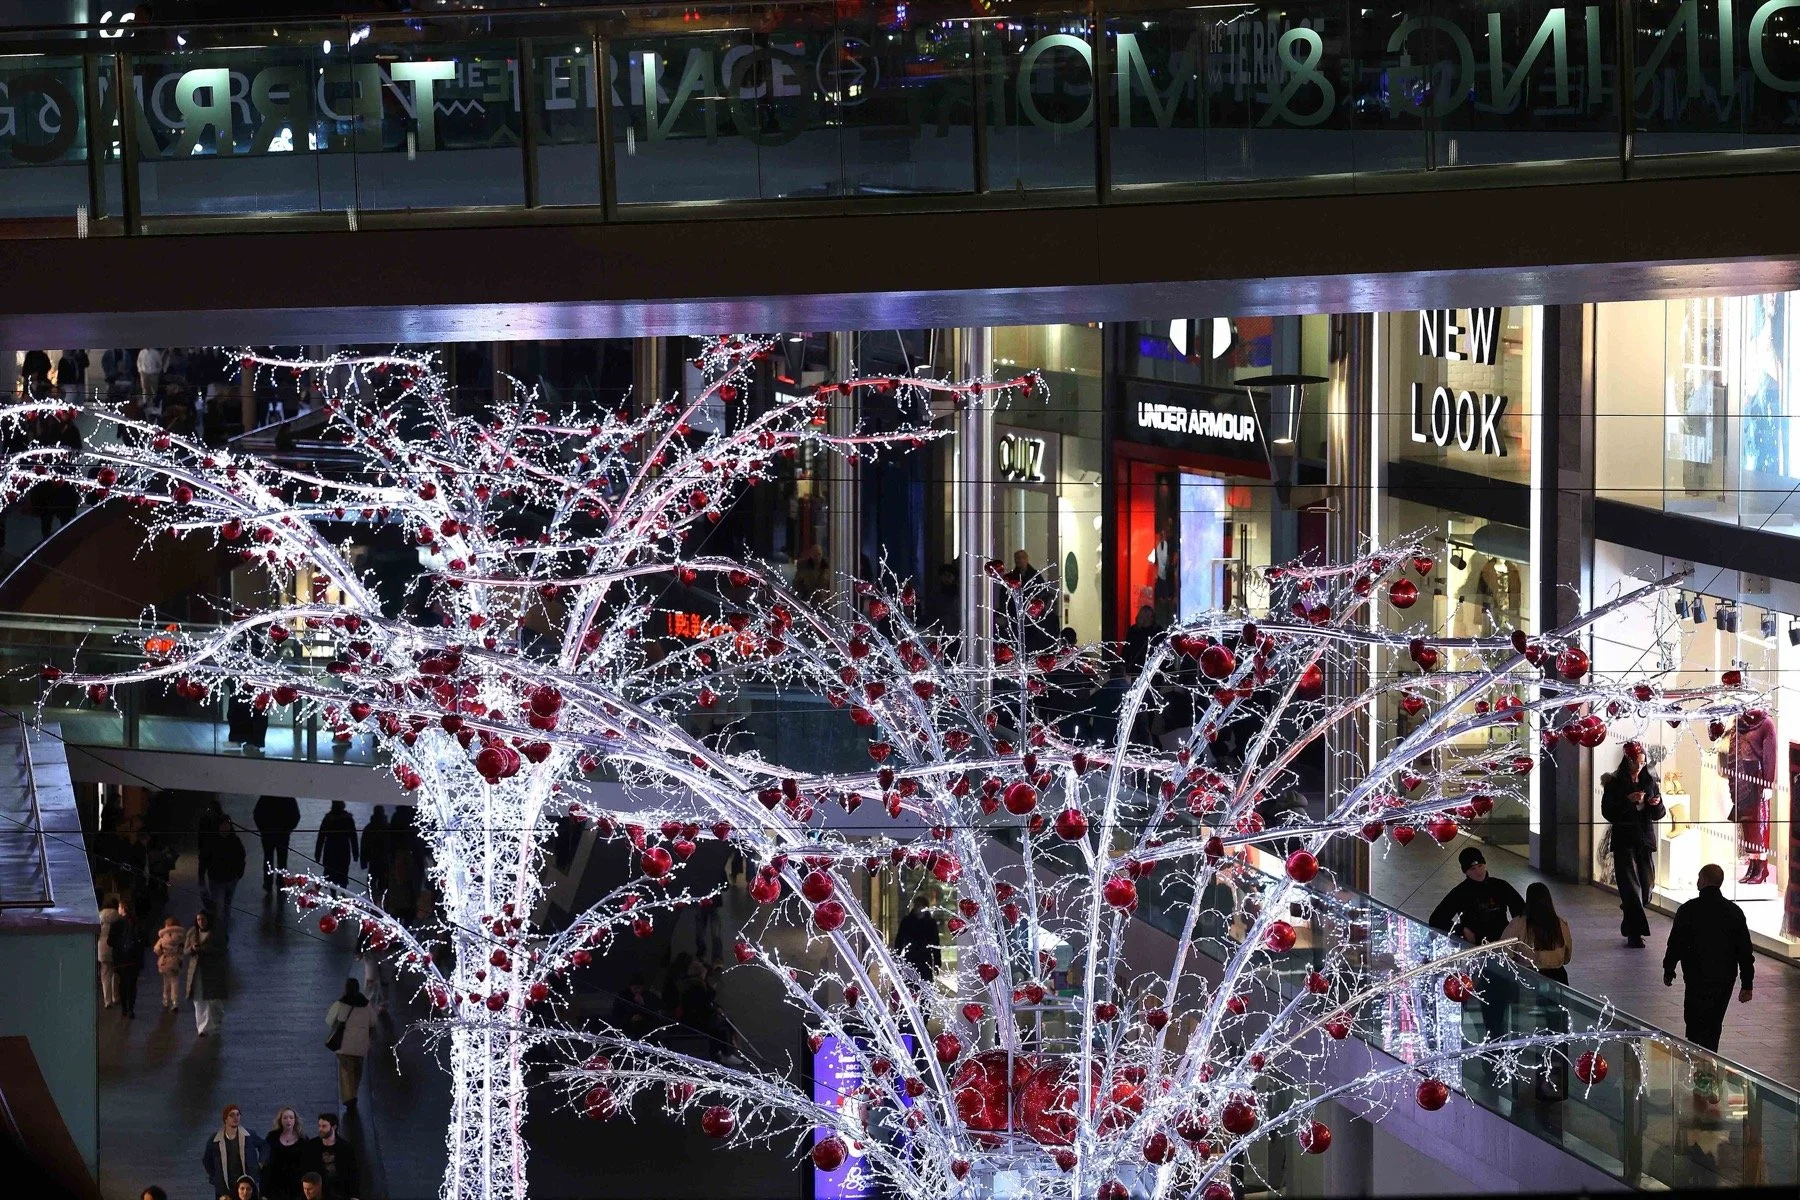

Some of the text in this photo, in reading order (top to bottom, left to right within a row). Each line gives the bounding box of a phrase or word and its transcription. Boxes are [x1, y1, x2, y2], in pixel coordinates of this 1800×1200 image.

[1418, 306, 1498, 367] NEW
[1138, 401, 1255, 443] UNDER ARMOUR
[1411, 381, 1504, 459] LOOK
[998, 432, 1046, 483] QUIZ
